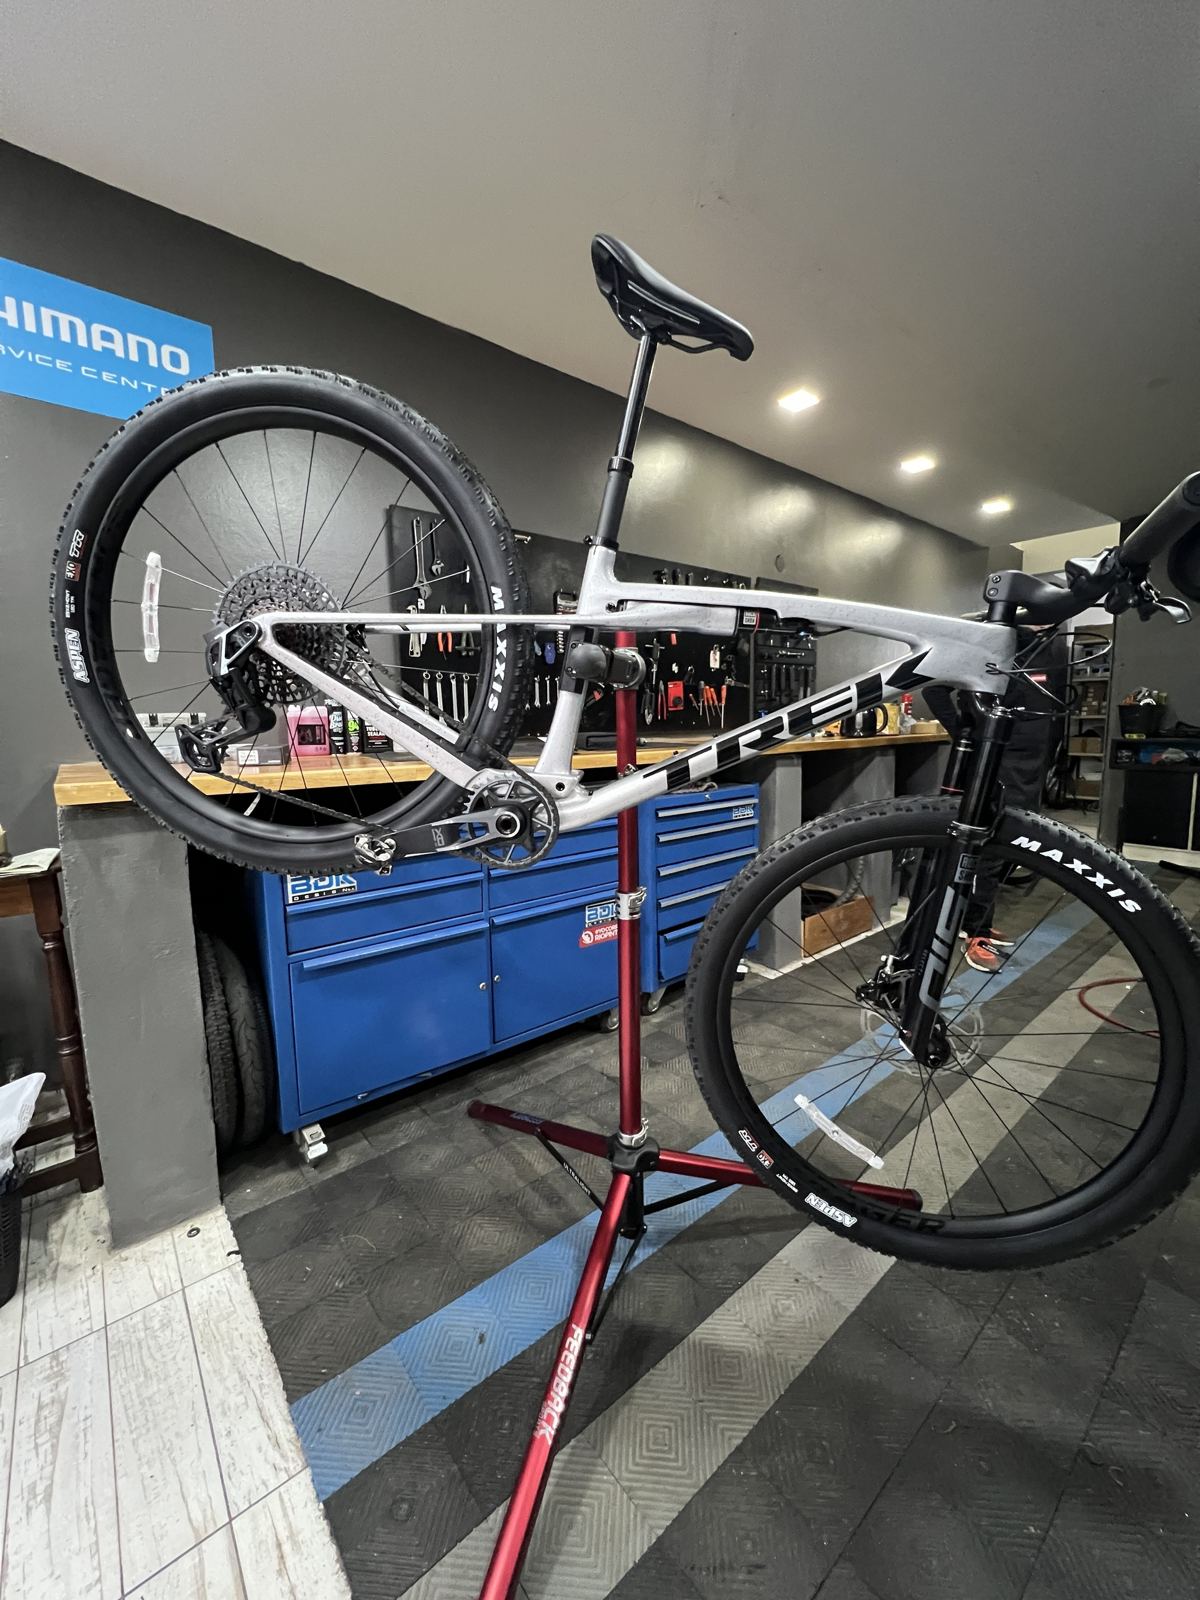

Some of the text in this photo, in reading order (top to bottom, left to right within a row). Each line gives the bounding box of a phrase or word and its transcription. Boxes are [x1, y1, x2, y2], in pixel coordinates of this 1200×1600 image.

[65, 628, 90, 684] ASPEN
[643, 647, 936, 790] TREK
[1011, 836, 1142, 913] MAXXIS
[804, 1193, 858, 1228] ASPEN
[538, 1323, 584, 1446] FEEDBACK
